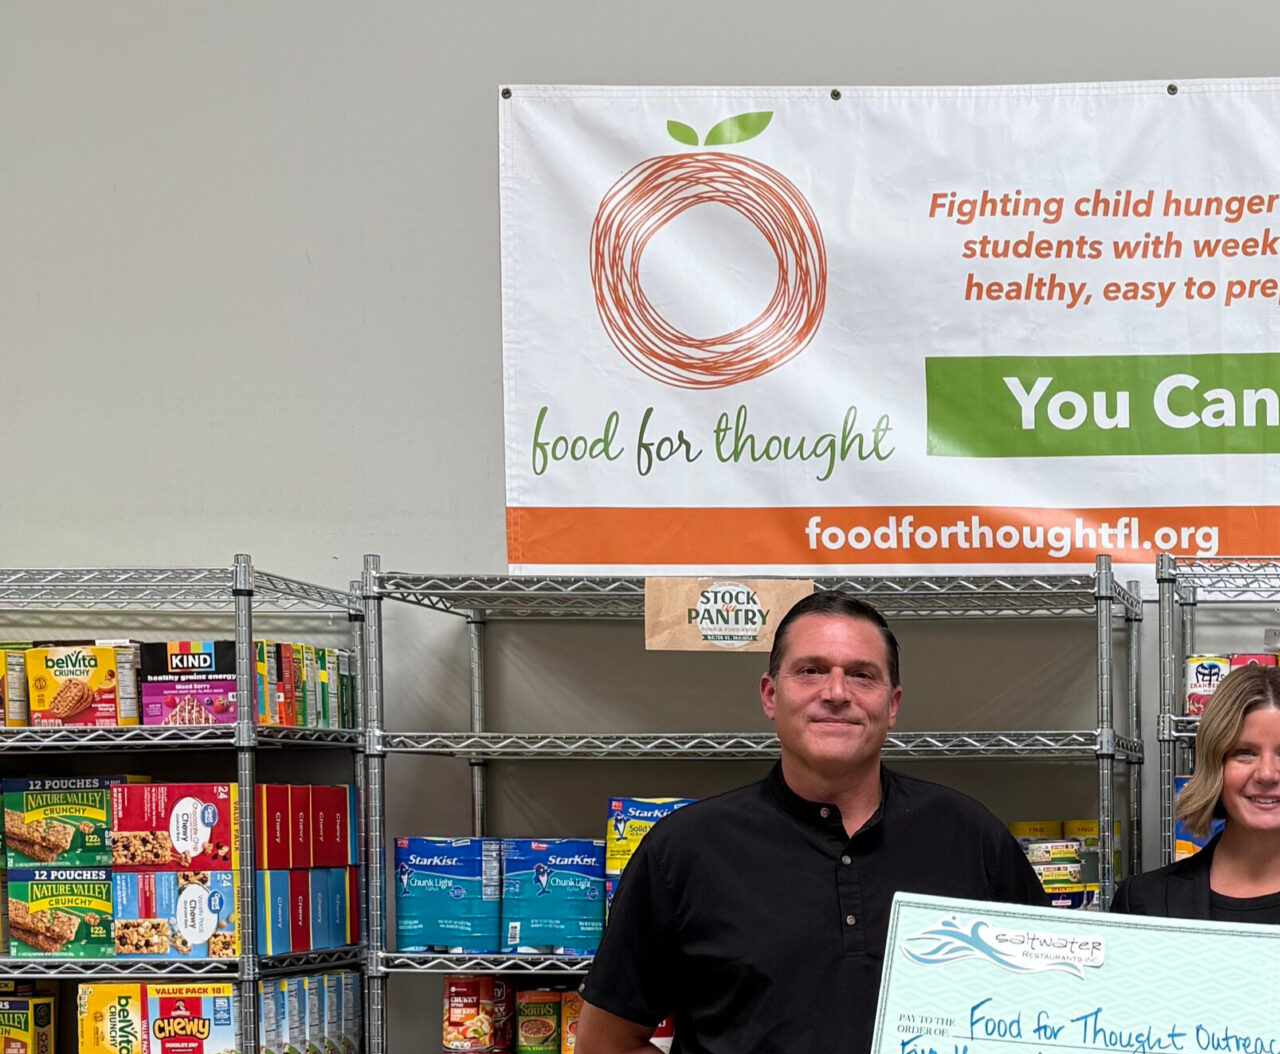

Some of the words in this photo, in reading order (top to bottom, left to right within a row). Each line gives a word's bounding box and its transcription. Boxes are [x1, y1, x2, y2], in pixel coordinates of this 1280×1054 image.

[928, 191, 1063, 224] Fighting
[1073, 190, 1155, 218] child
[1162, 190, 1279, 223] hunger
[962, 231, 1102, 260] students
[1112, 231, 1183, 259] with
[964, 273, 1094, 308] healthy,
[1102, 279, 1175, 308] easy
[1184, 277, 1216, 301] to
[1003, 375, 1130, 429] You
[1152, 373, 1280, 428] Can
[531, 408, 624, 476] food
[636, 408, 704, 476] for
[713, 408, 896, 481] thought
[805, 514, 1219, 557] foodforthoughtfl.org
[700, 590, 757, 605] STOCK
[688, 608, 770, 625] PANTRY
[45, 650, 97, 669] belVita
[171, 655, 211, 668] KIND
[53, 668, 91, 677] CRUNCHY
[147, 673, 180, 682] healthy
[179, 672, 207, 682] grains
[207, 673, 238, 681] energy
[28, 780, 42, 790] 12
[45, 779, 100, 789] POUCHES
[27, 794, 66, 810] NATURE
[66, 792, 102, 808] VALLEY
[42, 806, 88, 817] CRUNCHY
[409, 855, 457, 865] StarKist
[548, 855, 596, 865] StarKist
[34, 870, 47, 880] 12
[50, 870, 106, 880] POUCHES
[32, 884, 72, 900] NATURE
[73, 883, 109, 900] VALLEY
[47, 897, 94, 907] CRUNCHY
[995, 932, 1102, 953] saltwater
[1022, 951, 1083, 962] RESTAURANTS
[898, 1013, 918, 1024] PAY
[919, 1015, 933, 1025] TO
[934, 1016, 956, 1026] THE
[970, 997, 1021, 1040] Food
[1033, 1011, 1065, 1041] for
[154, 1018, 209, 1038] CHEWY
[897, 1025, 929, 1036] ORDER
